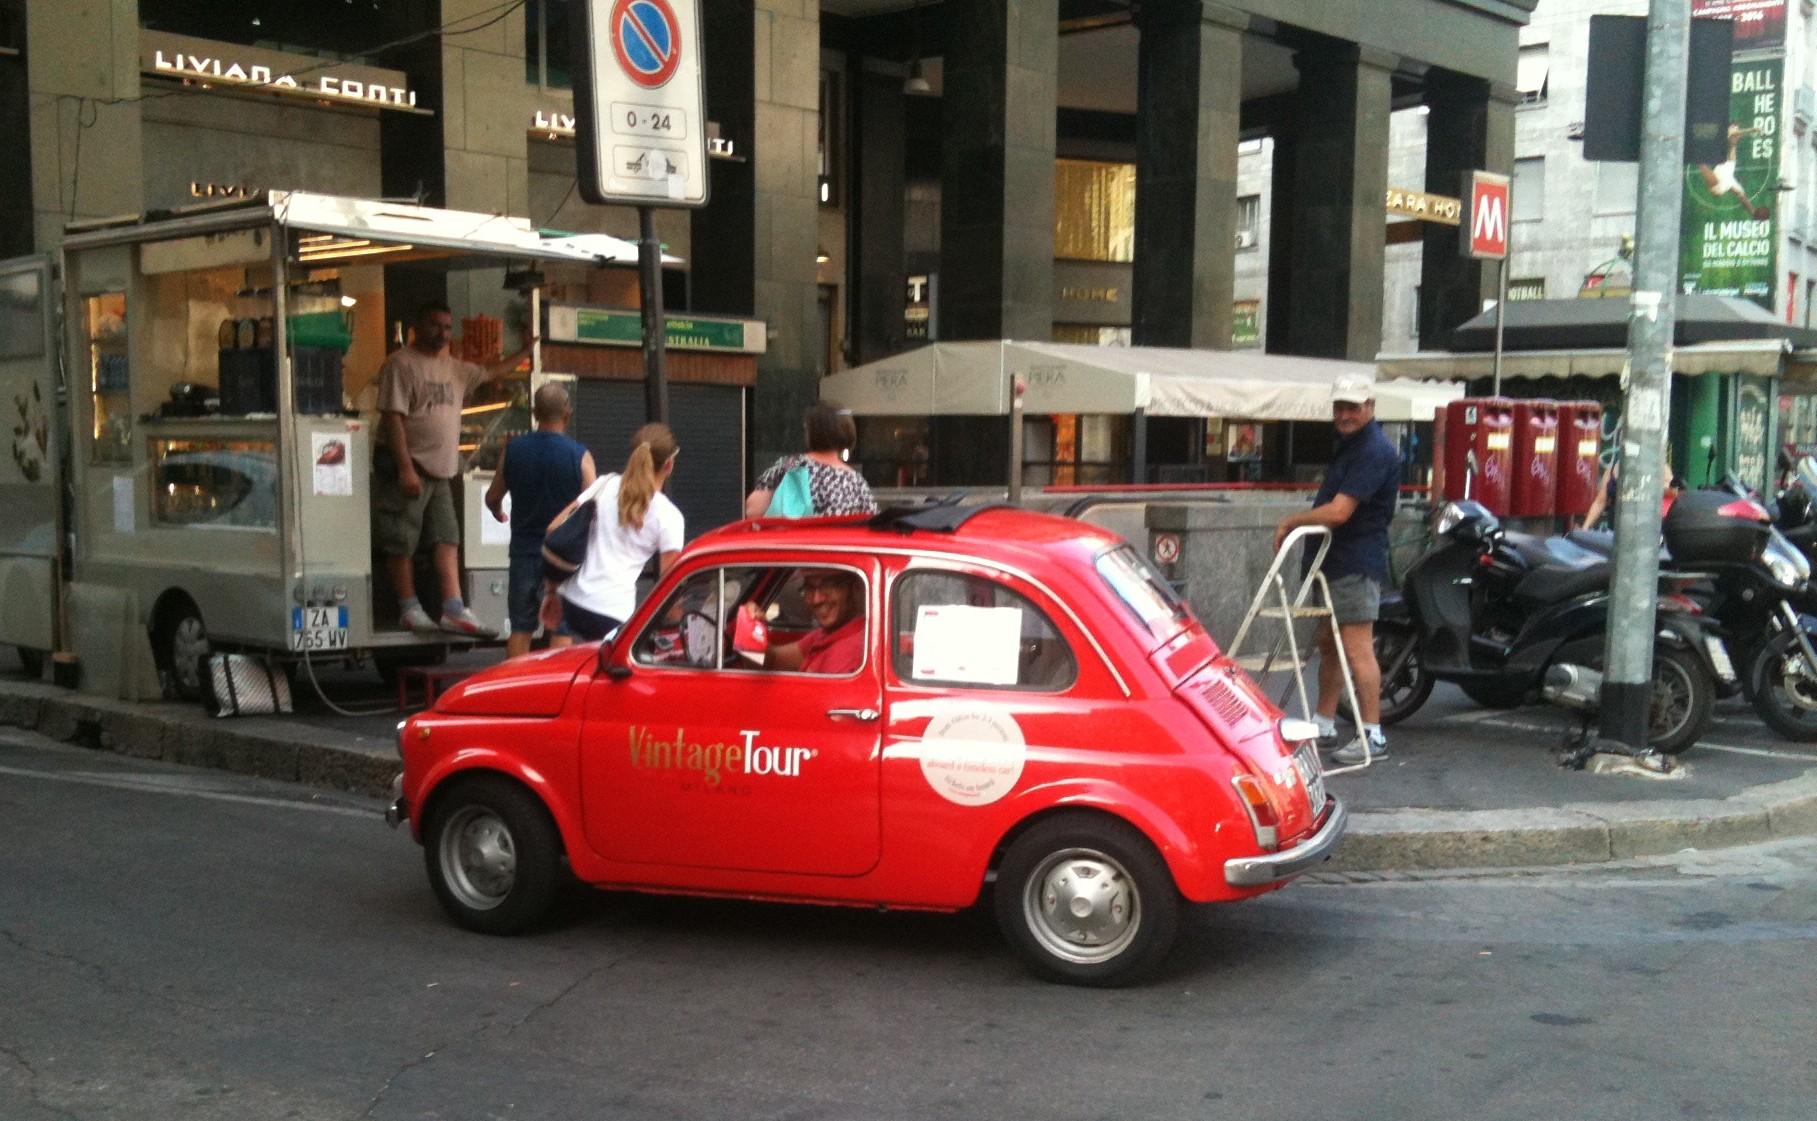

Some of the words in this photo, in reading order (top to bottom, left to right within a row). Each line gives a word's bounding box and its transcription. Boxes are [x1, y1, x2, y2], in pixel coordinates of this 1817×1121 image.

[156, 50, 297, 88] LIVIANA
[320, 76, 416, 107] CONTI
[1731, 69, 1776, 93] BALL
[1754, 92, 1776, 115] HE
[1752, 138, 1774, 159] ES
[1385, 190, 1427, 212] ZARA
[1474, 194, 1505, 243] M
[1704, 222, 1718, 241] IL
[1720, 219, 1770, 240] MUSEO
[1703, 241, 1725, 259] DEL
[1726, 239, 1770, 257] CALCIO
[310, 609, 330, 627] ZA
